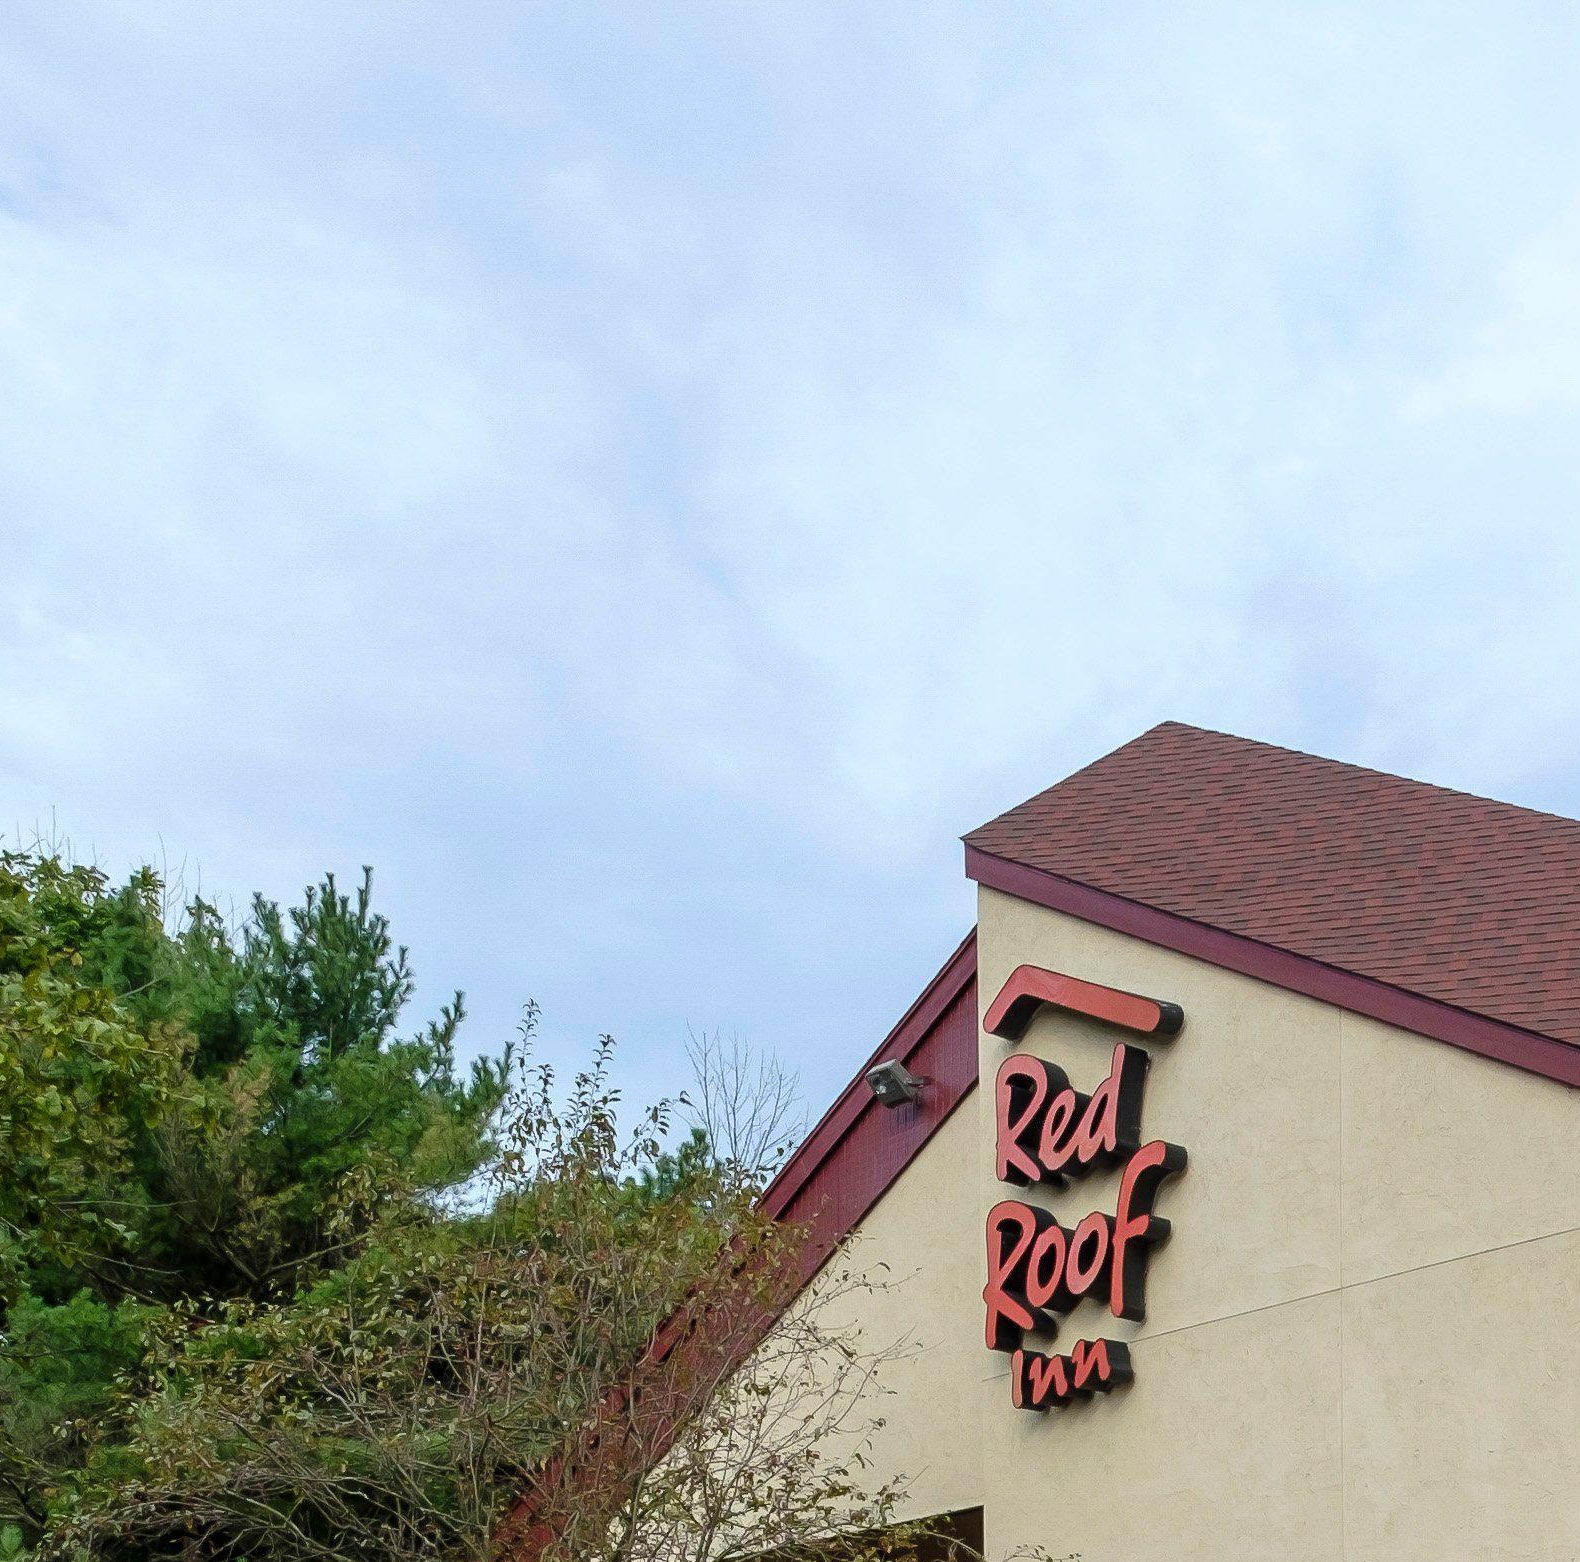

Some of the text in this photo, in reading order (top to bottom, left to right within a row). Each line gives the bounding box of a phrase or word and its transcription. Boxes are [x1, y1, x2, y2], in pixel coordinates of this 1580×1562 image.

[995, 1042, 1126, 1182] Red
[983, 1140, 1167, 1351] Roof
[1011, 1338, 1112, 1409] Inn
